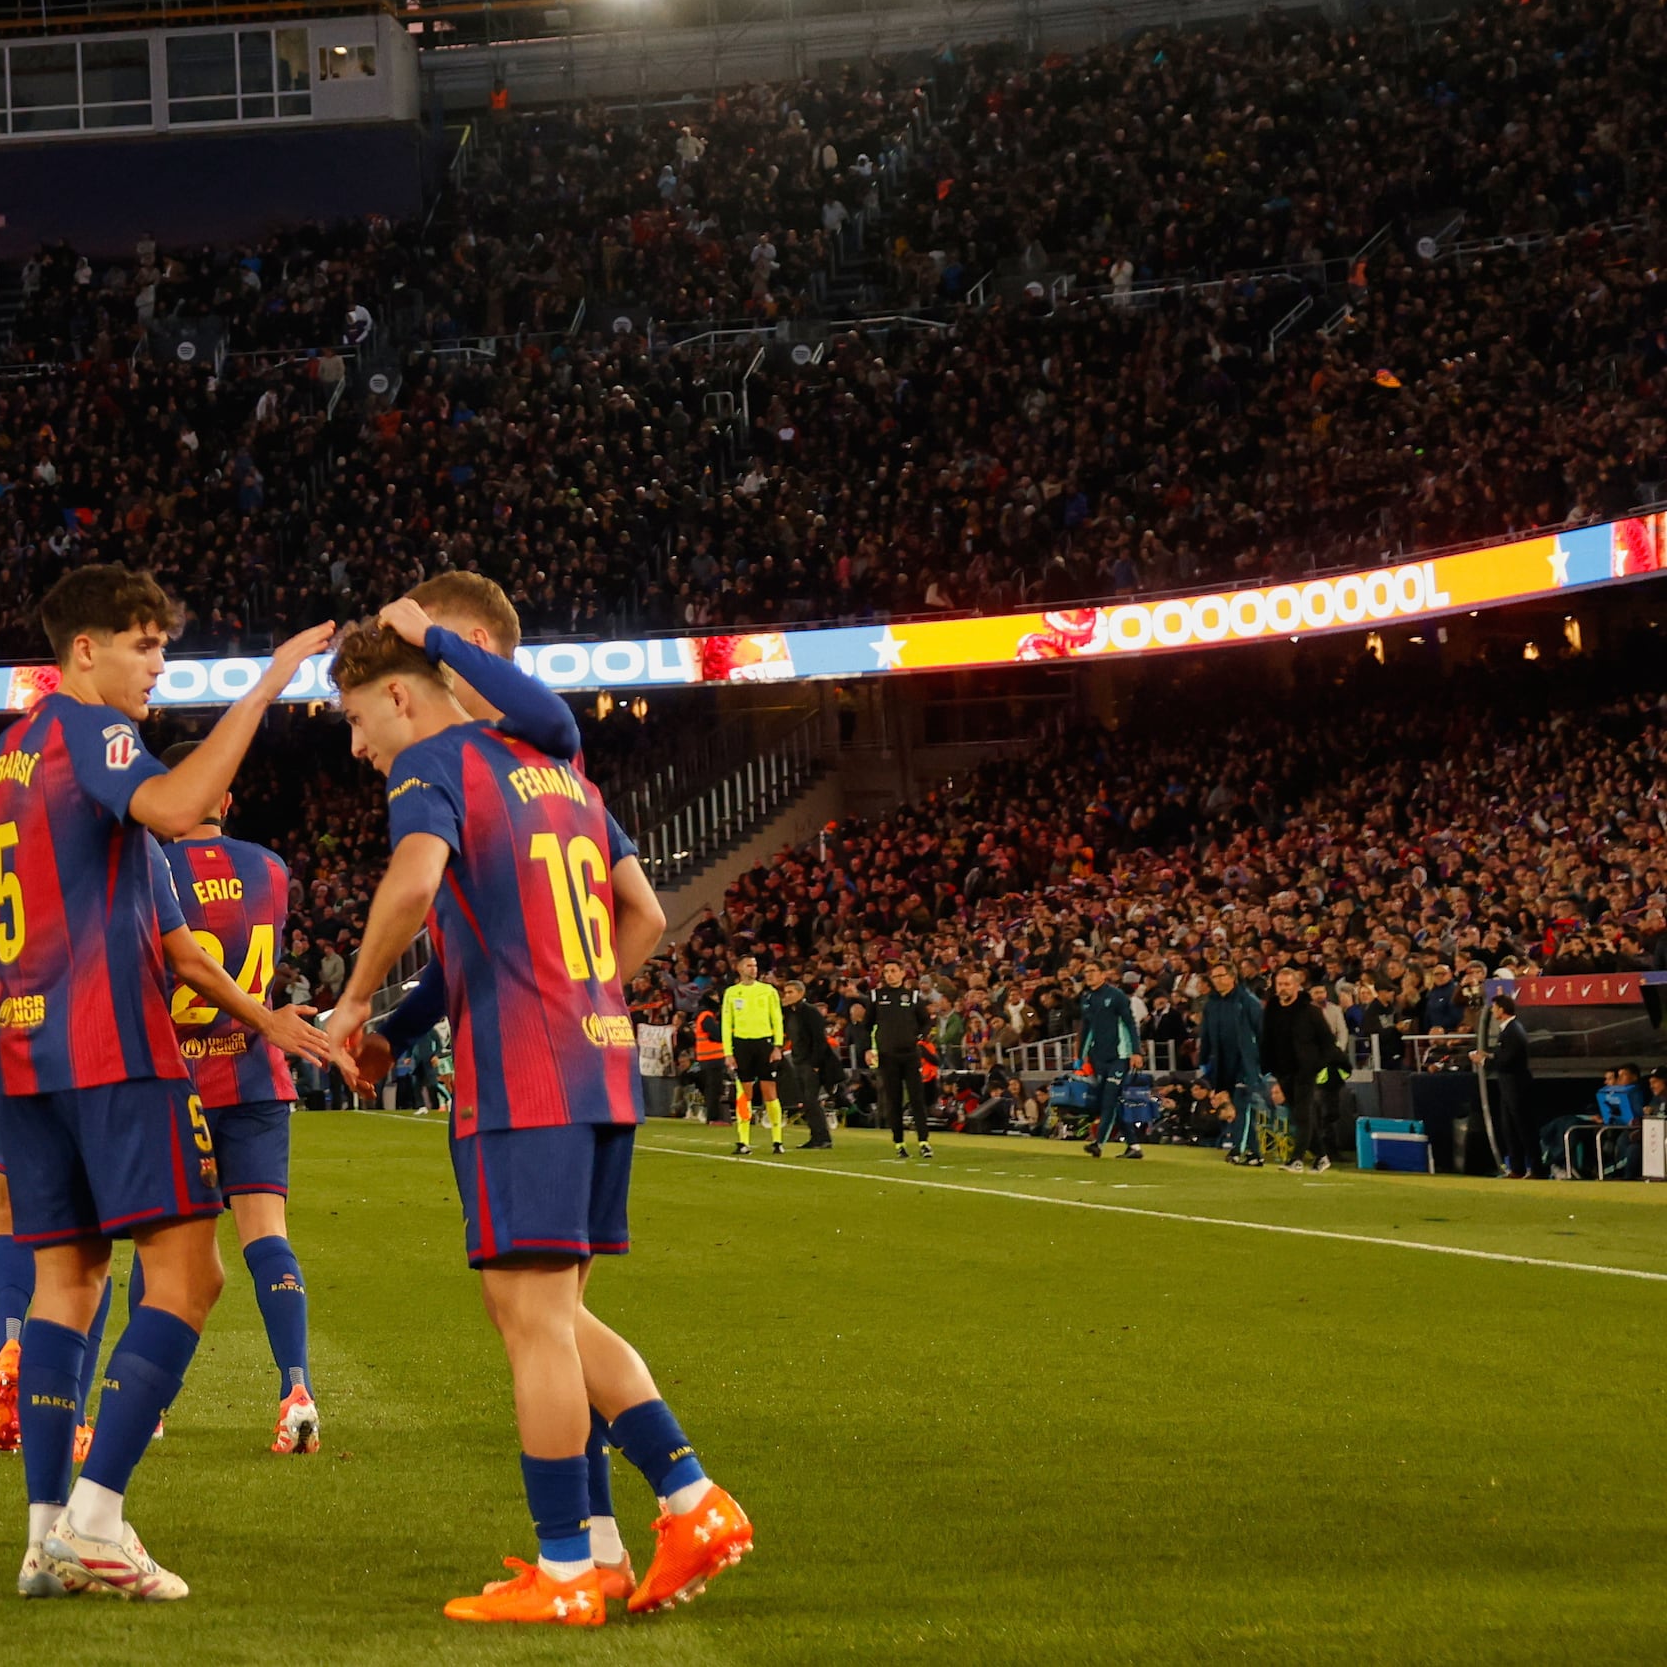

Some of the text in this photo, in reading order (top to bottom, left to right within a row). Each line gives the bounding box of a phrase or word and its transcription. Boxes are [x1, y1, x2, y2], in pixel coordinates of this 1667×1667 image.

[192, 878, 243, 905] ERIC
[530, 833, 616, 983] 16
[12, 995, 45, 1009] HCR
[170, 924, 275, 1024] 24
[188, 1094, 213, 1151] 5
